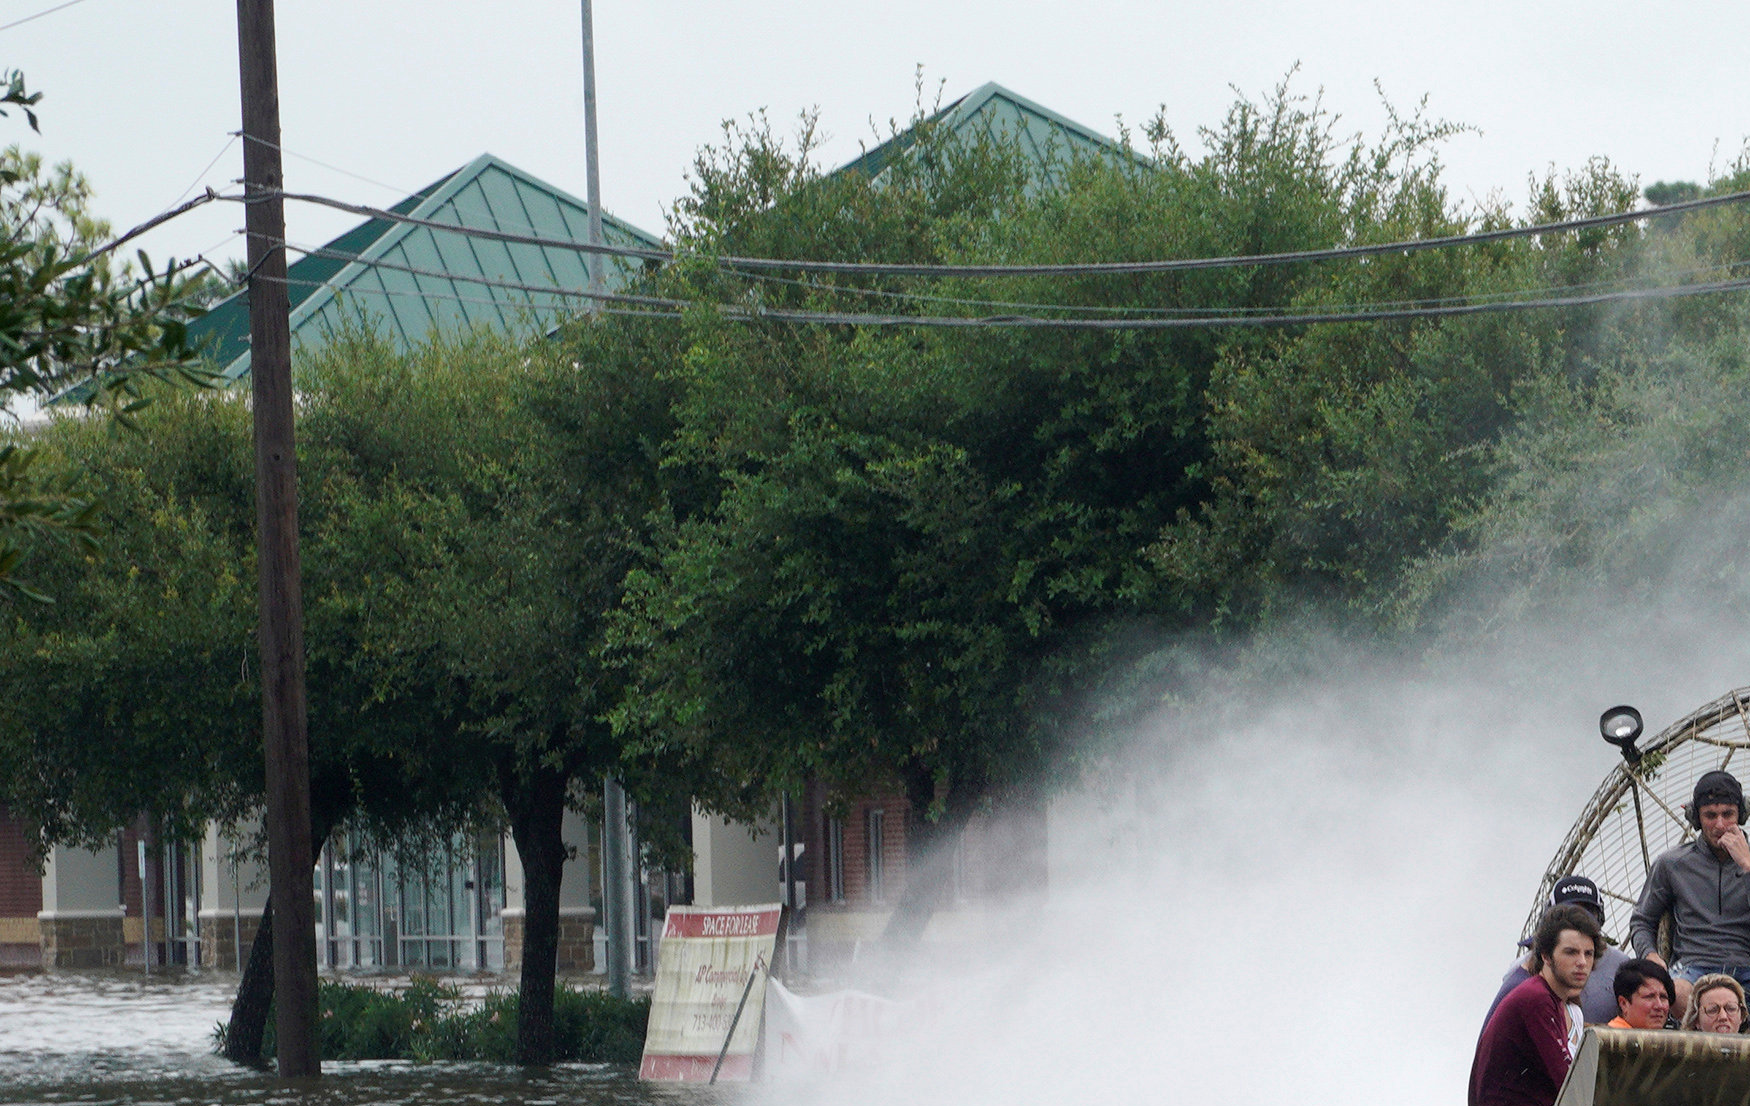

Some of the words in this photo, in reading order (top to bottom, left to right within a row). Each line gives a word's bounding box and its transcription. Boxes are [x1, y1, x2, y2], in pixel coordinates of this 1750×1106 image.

[703, 916, 725, 936] SPACE
[725, 915, 741, 936] FOR
[740, 913, 760, 935] LEASE
